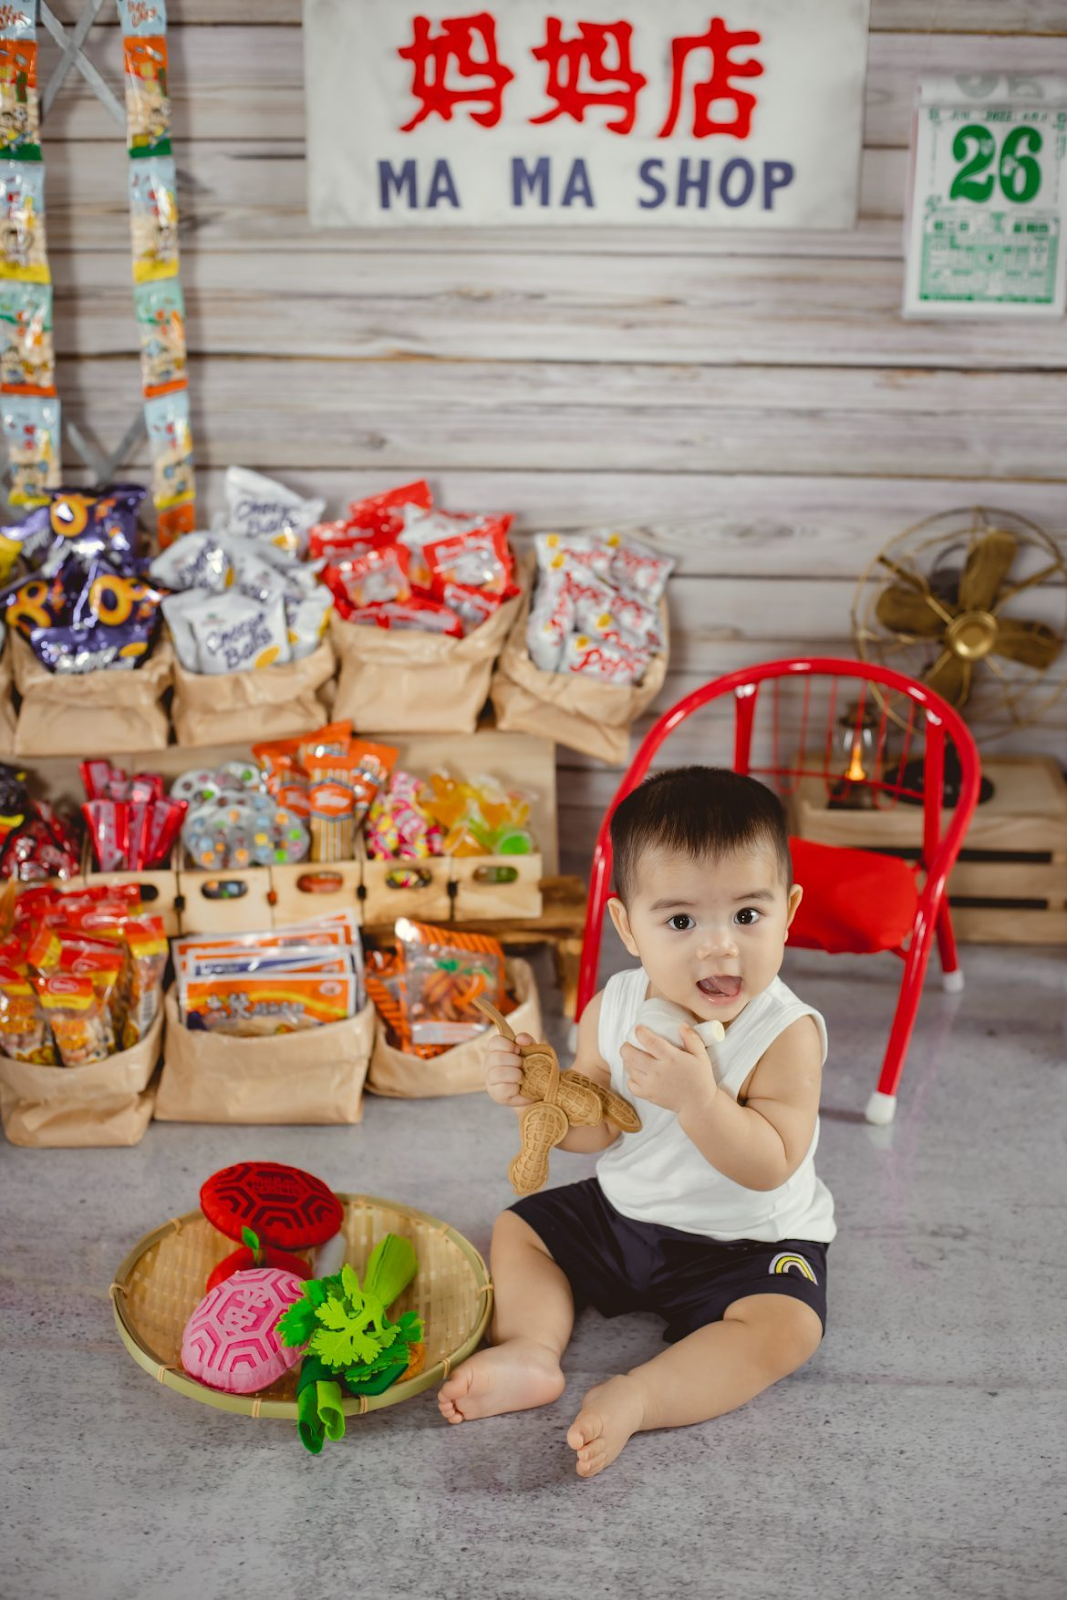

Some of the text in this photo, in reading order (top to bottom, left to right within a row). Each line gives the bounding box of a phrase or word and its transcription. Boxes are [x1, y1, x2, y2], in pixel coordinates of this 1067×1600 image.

[397, 11, 765, 140] 妈妈店
[377, 157, 796, 211] MA MA SHOP
[949, 124, 1043, 204] 26
